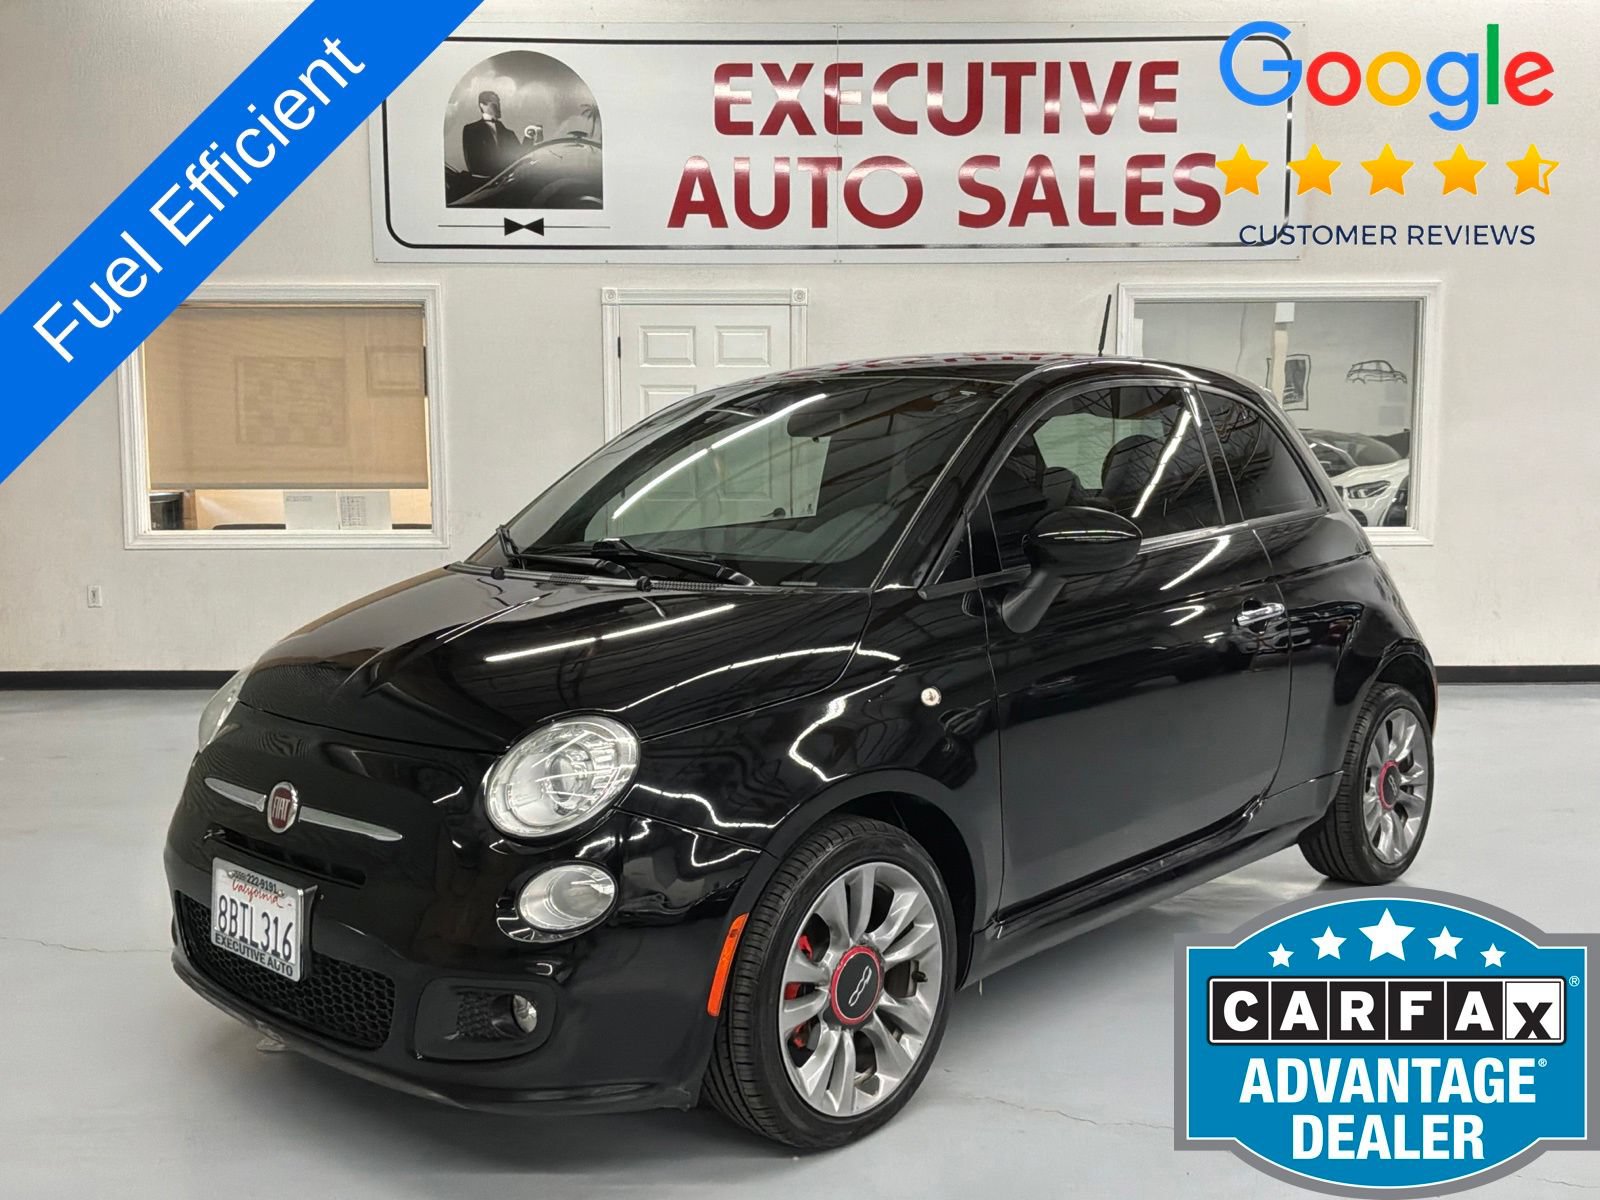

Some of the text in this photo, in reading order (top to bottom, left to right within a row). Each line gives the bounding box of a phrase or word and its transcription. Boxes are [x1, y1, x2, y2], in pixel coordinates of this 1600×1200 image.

[713, 61, 1180, 136] EXECUTIVE
[666, 152, 1222, 230] AUTO SALES
[272, 796, 291, 821] FIAT
[215, 932, 293, 977] EXECUTIVE AUTO
[218, 895, 293, 962] 8BIL316
